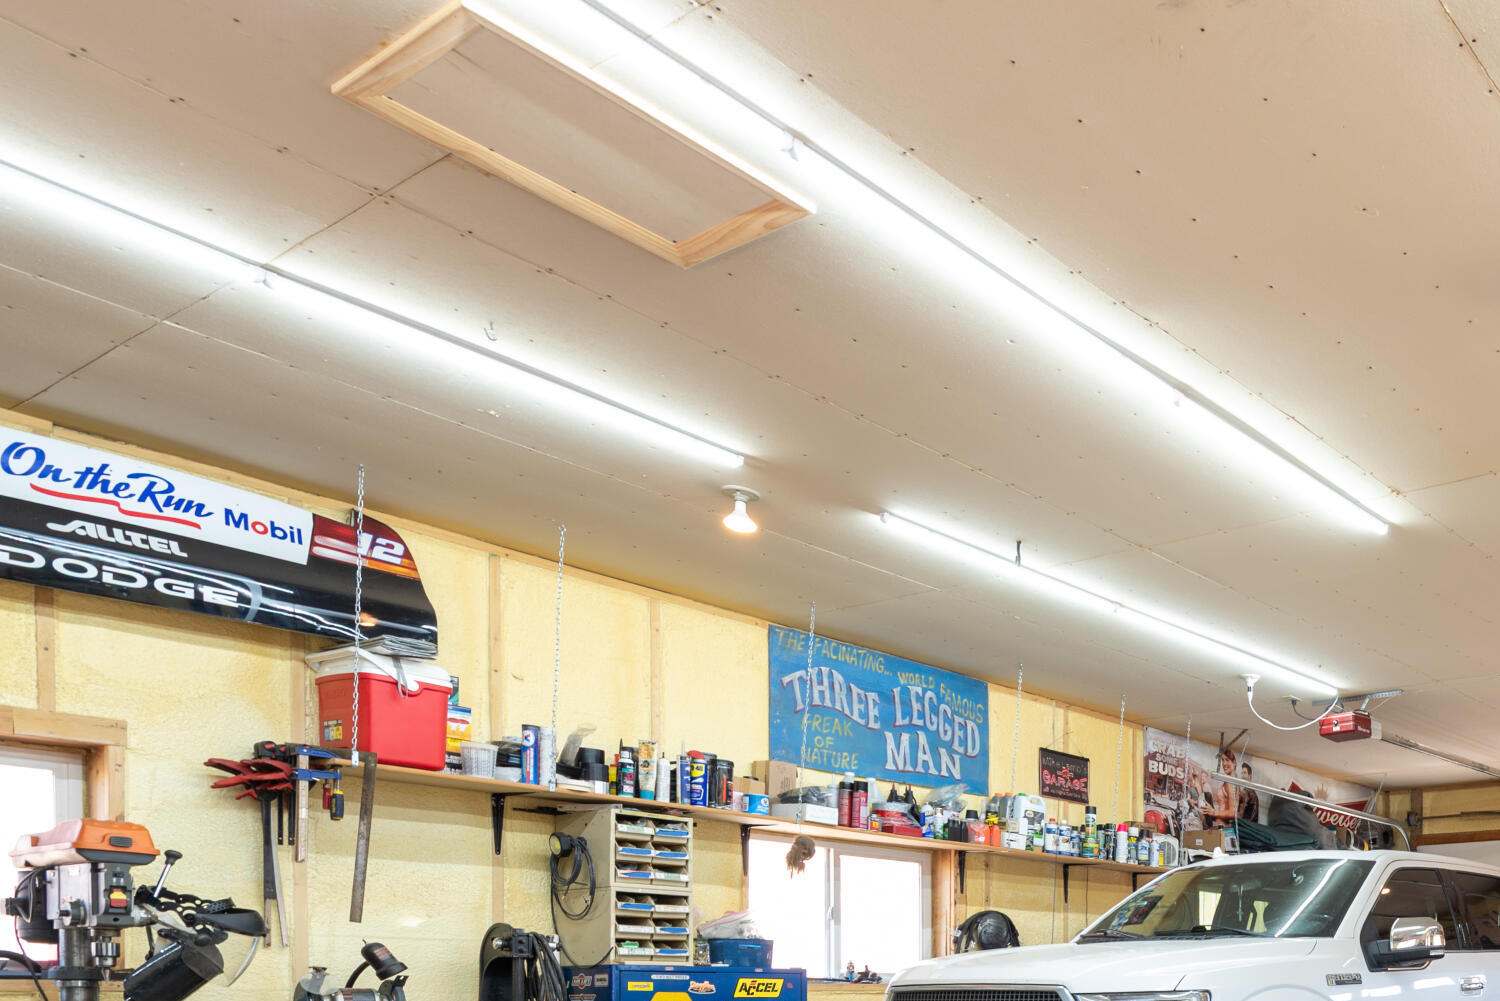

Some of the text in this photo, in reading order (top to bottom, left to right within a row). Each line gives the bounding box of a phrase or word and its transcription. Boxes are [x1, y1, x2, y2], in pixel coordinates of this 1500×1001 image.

[1, 442, 216, 518] On the Run
[46, 519, 188, 558] ALLTEL
[223, 507, 304, 546] Mobil
[0, 546, 240, 608] DODGE
[775, 628, 807, 651] THE
[896, 671, 936, 690] WORLD
[939, 683, 985, 725] FAMOUS
[780, 666, 980, 758] THREE LEGGED
[802, 713, 854, 737] FREAK
[802, 745, 860, 770] NATURE
[814, 736, 834, 748] OF
[883, 730, 962, 781] MAN
[1149, 740, 1187, 759] GRAB
[1156, 753, 1179, 766] SOME
[738, 980, 779, 996] ACCEL
